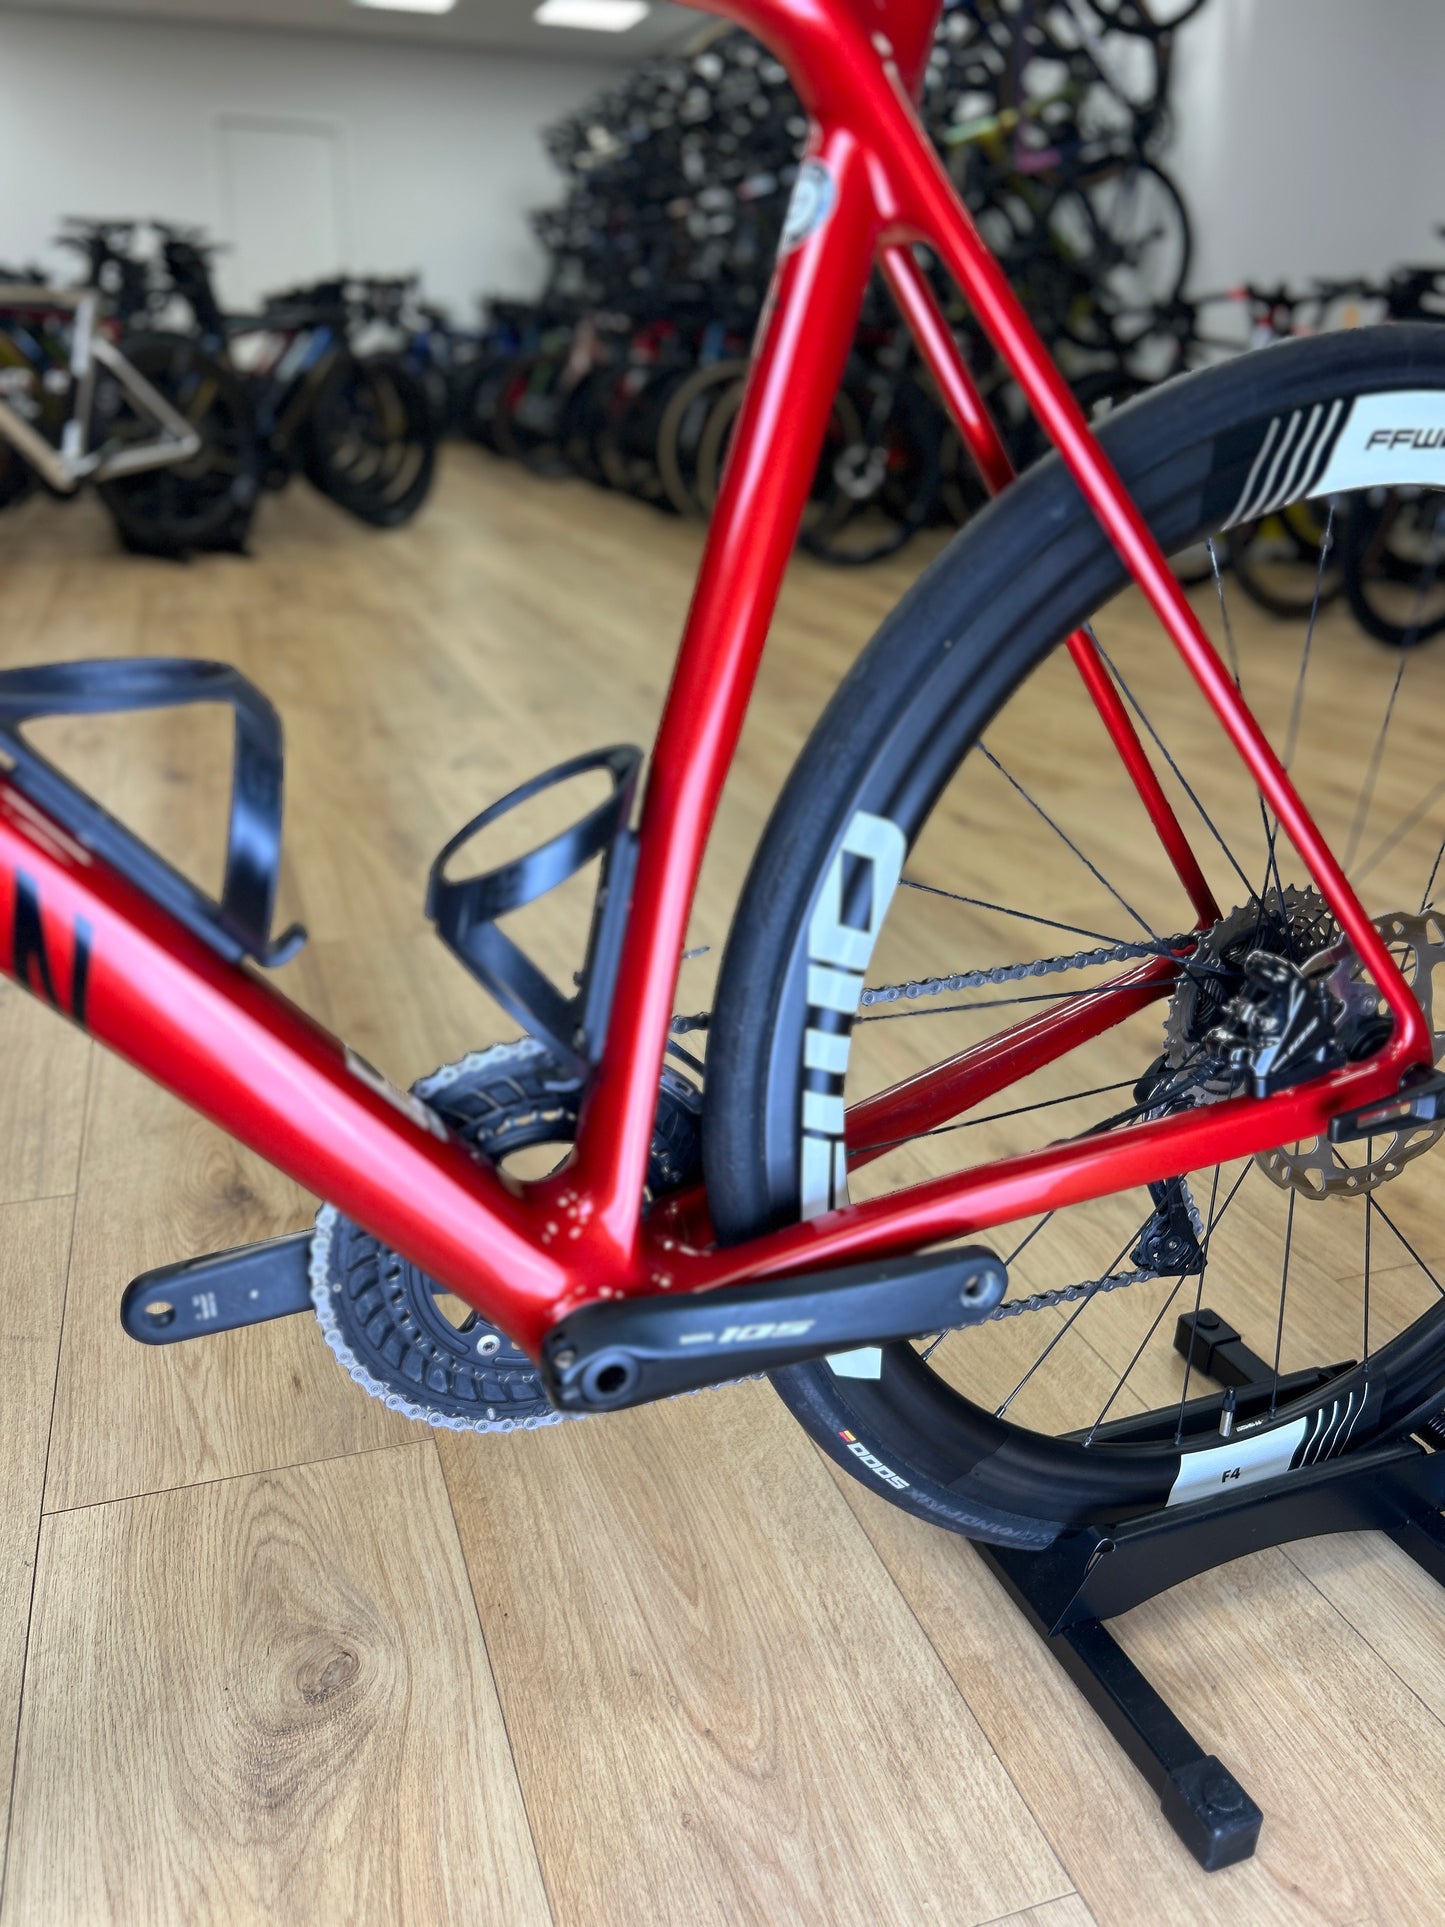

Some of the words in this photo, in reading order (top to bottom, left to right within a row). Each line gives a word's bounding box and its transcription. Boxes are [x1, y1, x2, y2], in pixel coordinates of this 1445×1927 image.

[1364, 428, 1445, 452] FFW
[718, 1318, 817, 1345] 105
[847, 1441, 910, 1490] 5000
[1221, 1467, 1241, 1484] F4
